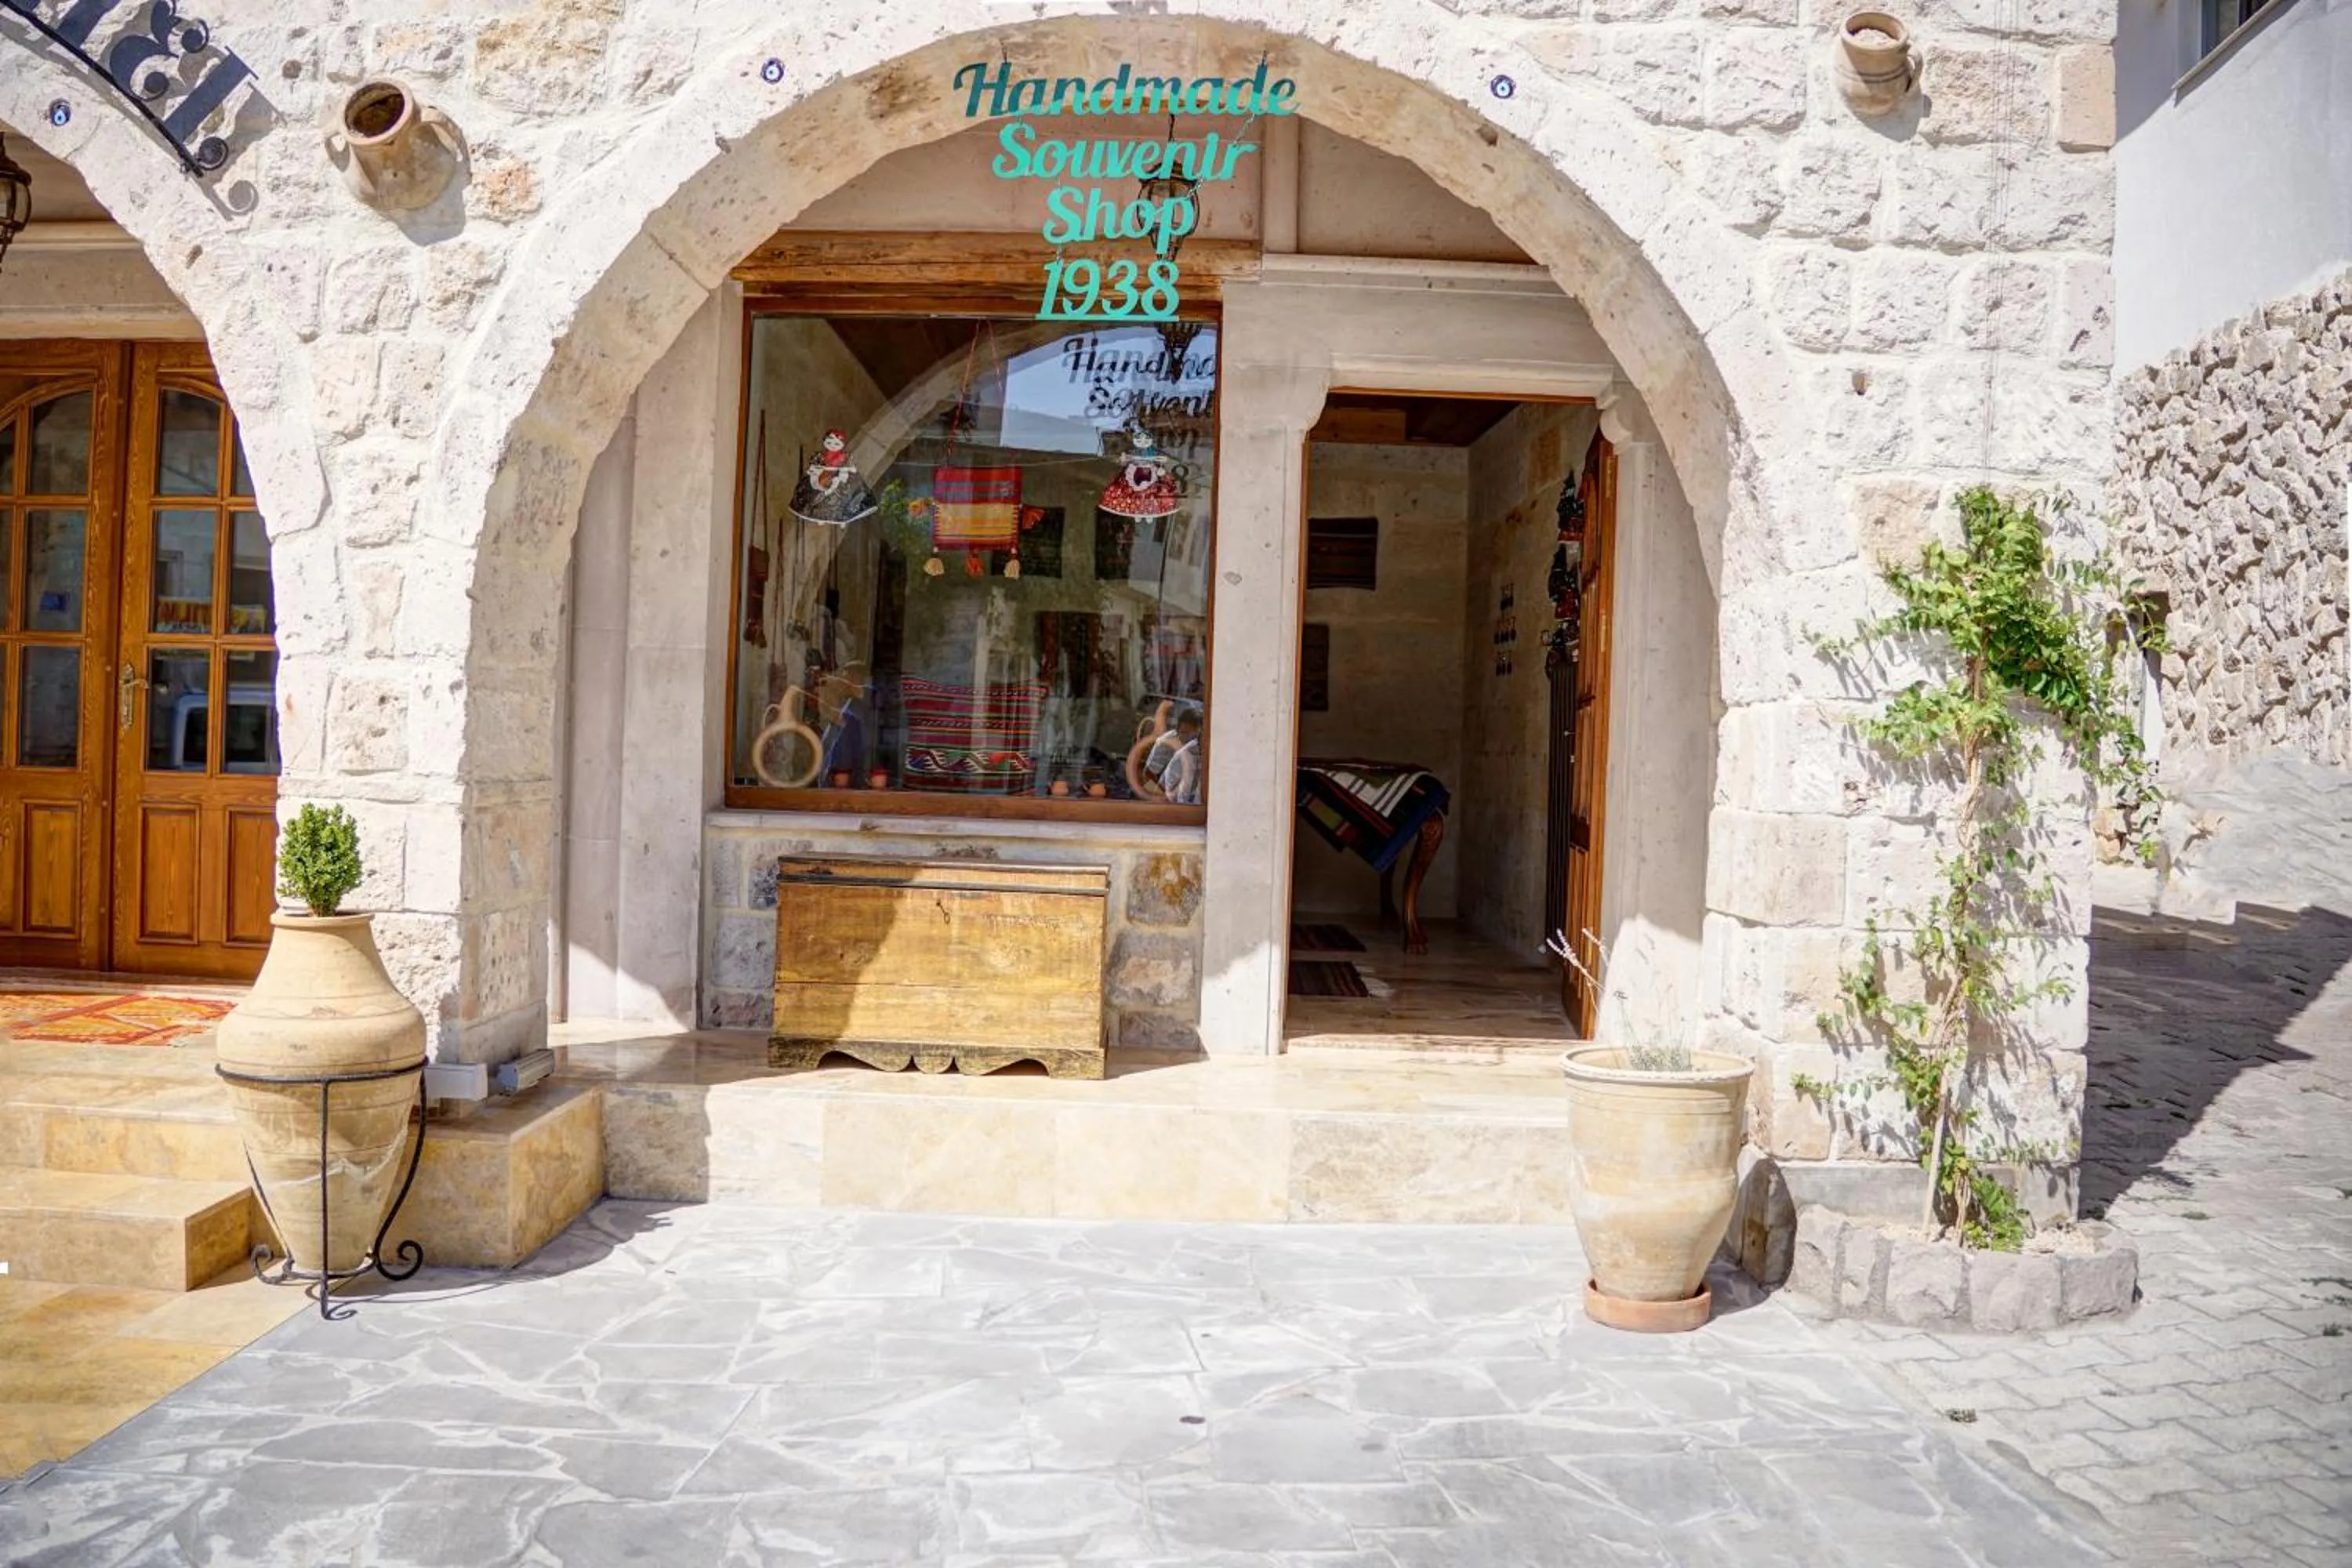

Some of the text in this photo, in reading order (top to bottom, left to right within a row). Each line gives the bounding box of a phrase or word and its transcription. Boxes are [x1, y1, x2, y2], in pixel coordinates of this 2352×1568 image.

[953, 62, 1298, 118] Handmade
[992, 122, 1259, 181] Souvenir
[1043, 185, 1196, 255] Shop
[1036, 259, 1179, 322] 1938
